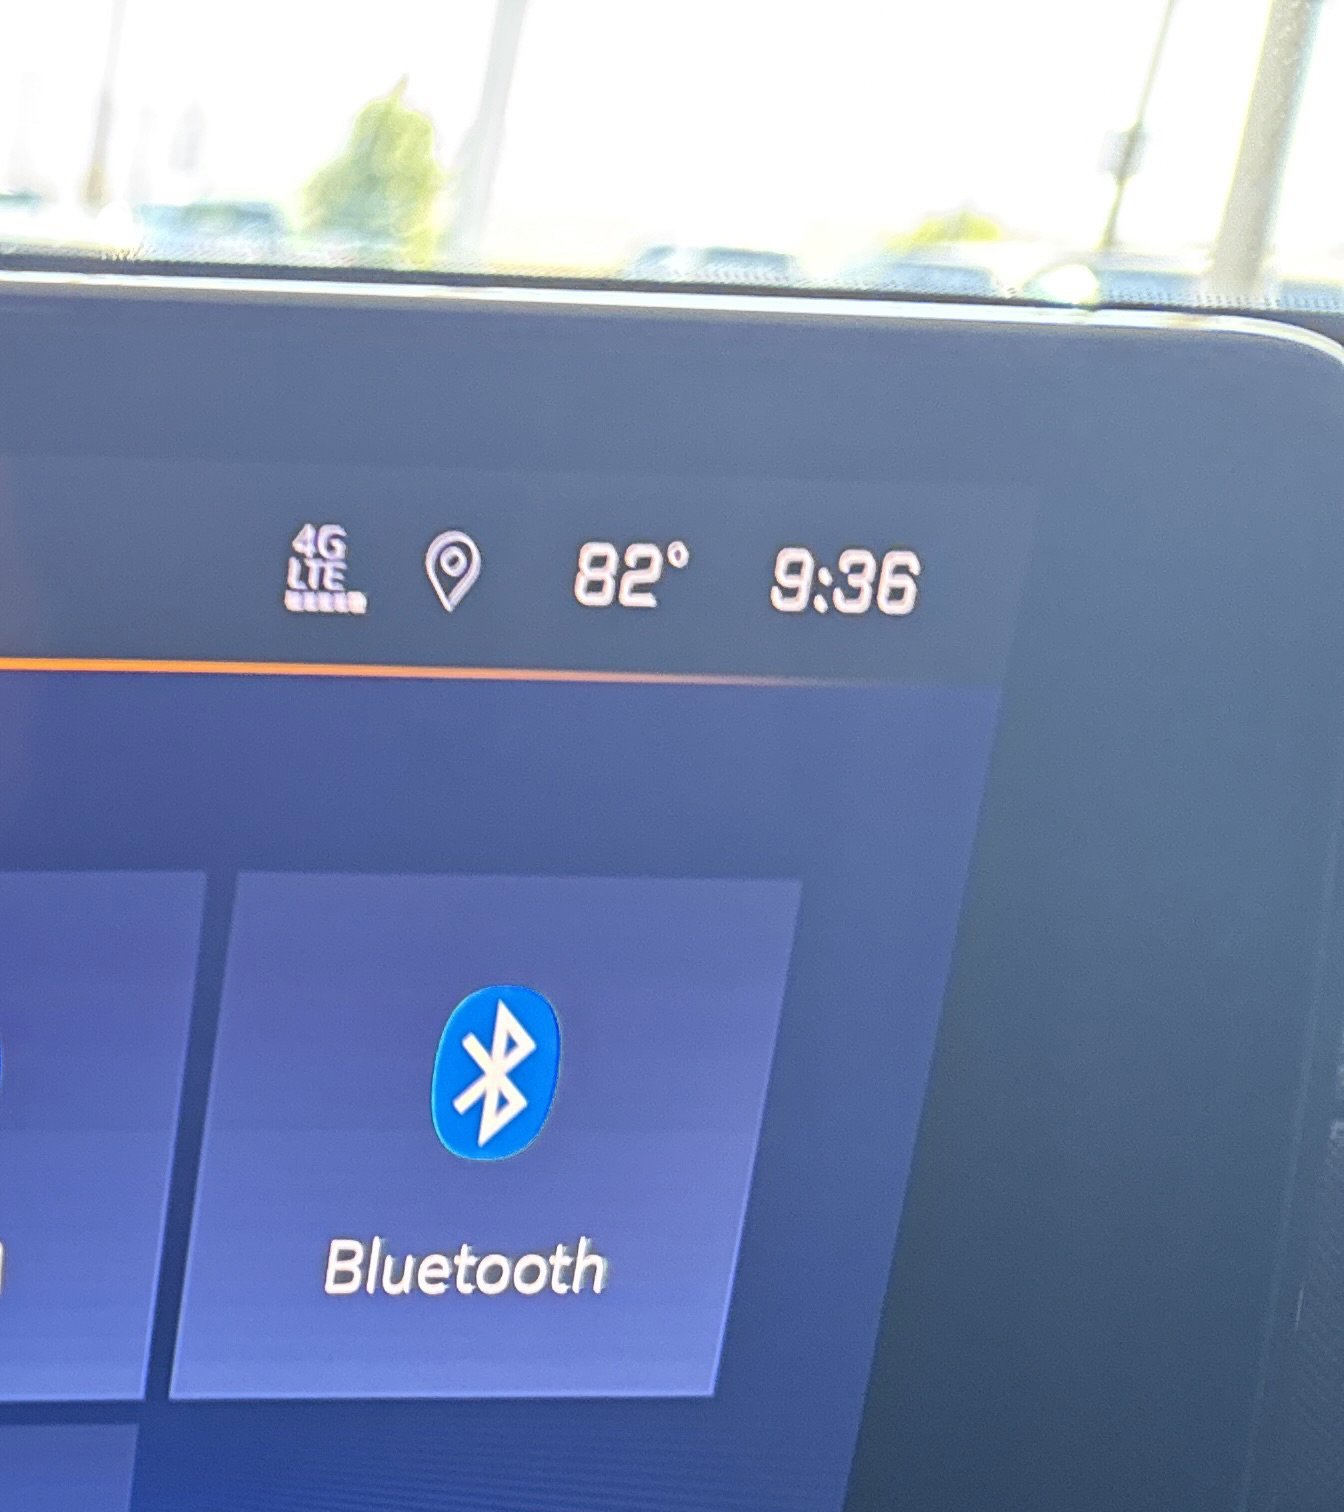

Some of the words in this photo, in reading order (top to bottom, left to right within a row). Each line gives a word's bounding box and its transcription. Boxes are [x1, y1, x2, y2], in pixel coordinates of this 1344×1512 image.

[291, 522, 348, 559] 4G
[286, 556, 348, 590] LTE
[770, 547, 921, 615] 9:36
[324, 1236, 607, 1295] Bluetooth
